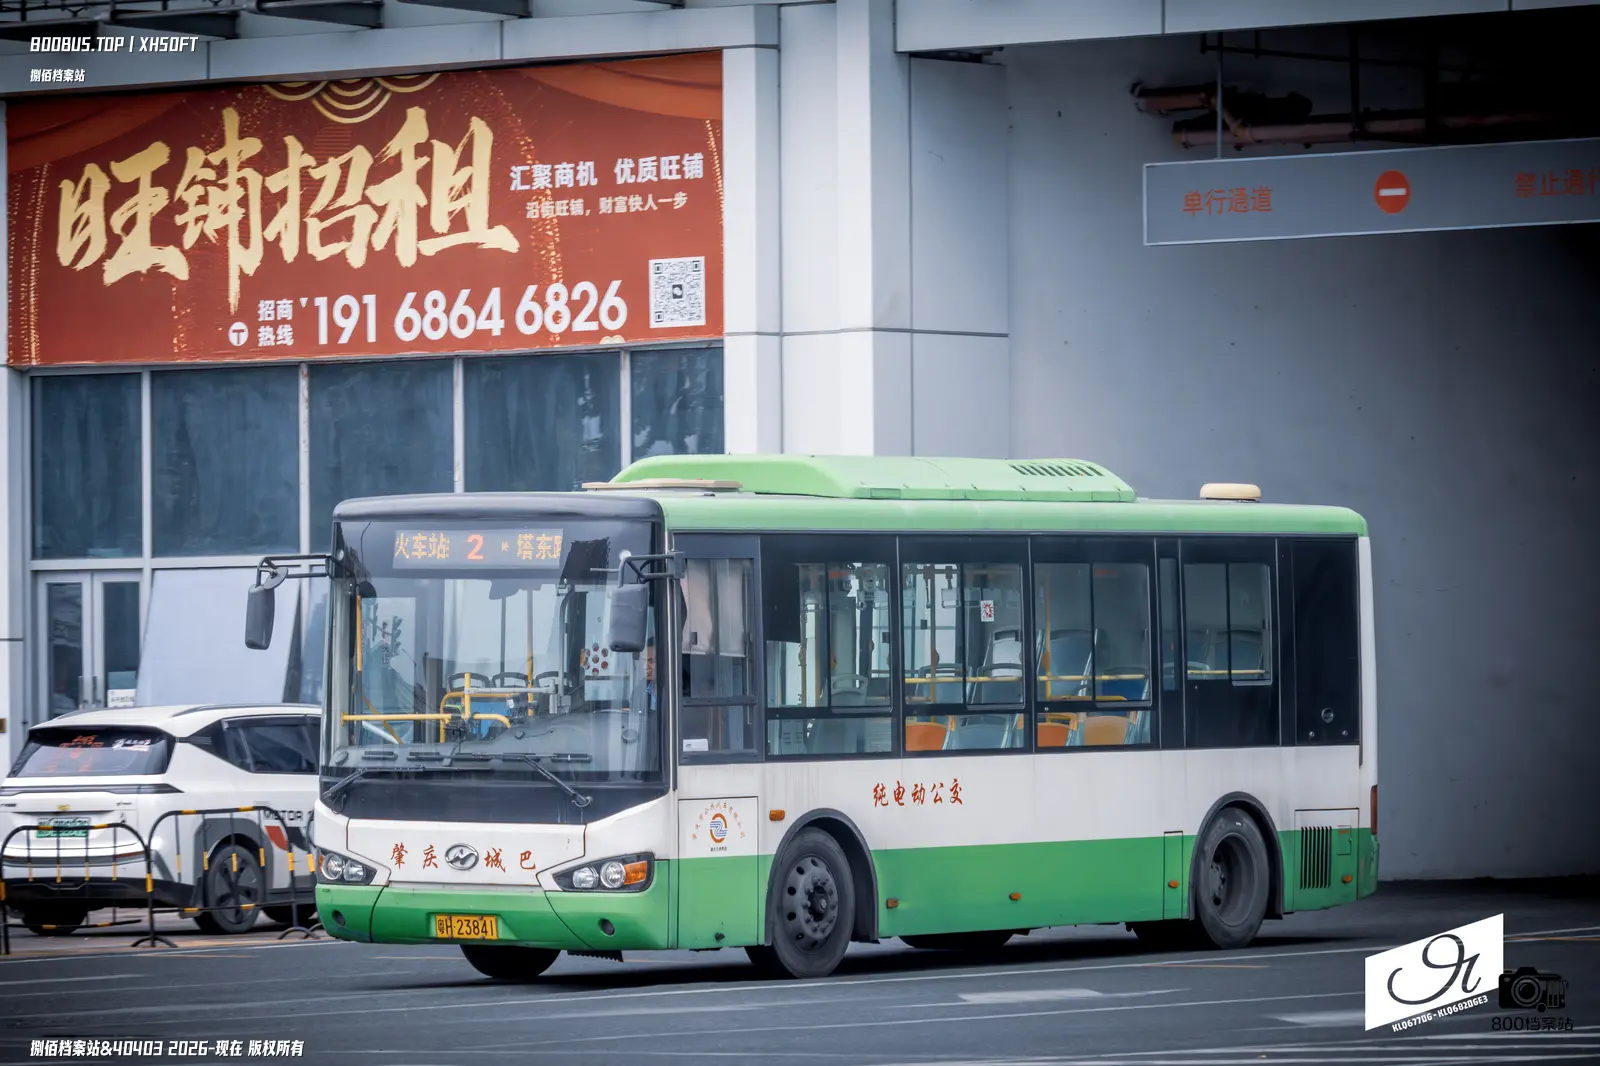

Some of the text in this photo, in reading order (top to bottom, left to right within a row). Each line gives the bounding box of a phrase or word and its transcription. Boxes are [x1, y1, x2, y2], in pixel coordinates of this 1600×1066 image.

[509, 152, 704, 191] 汇聚商机 优质旺铺
[56, 106, 520, 315] 旺铺招租
[1182, 185, 1274, 217] 单行通道
[257, 298, 294, 322] 招商
[394, 287, 505, 342] 6864
[515, 280, 628, 336] 6826
[257, 324, 294, 347] 热线
[395, 532, 450, 560] 火车站
[466, 534, 484, 560] 2
[873, 778, 963, 807] 纯电动公交
